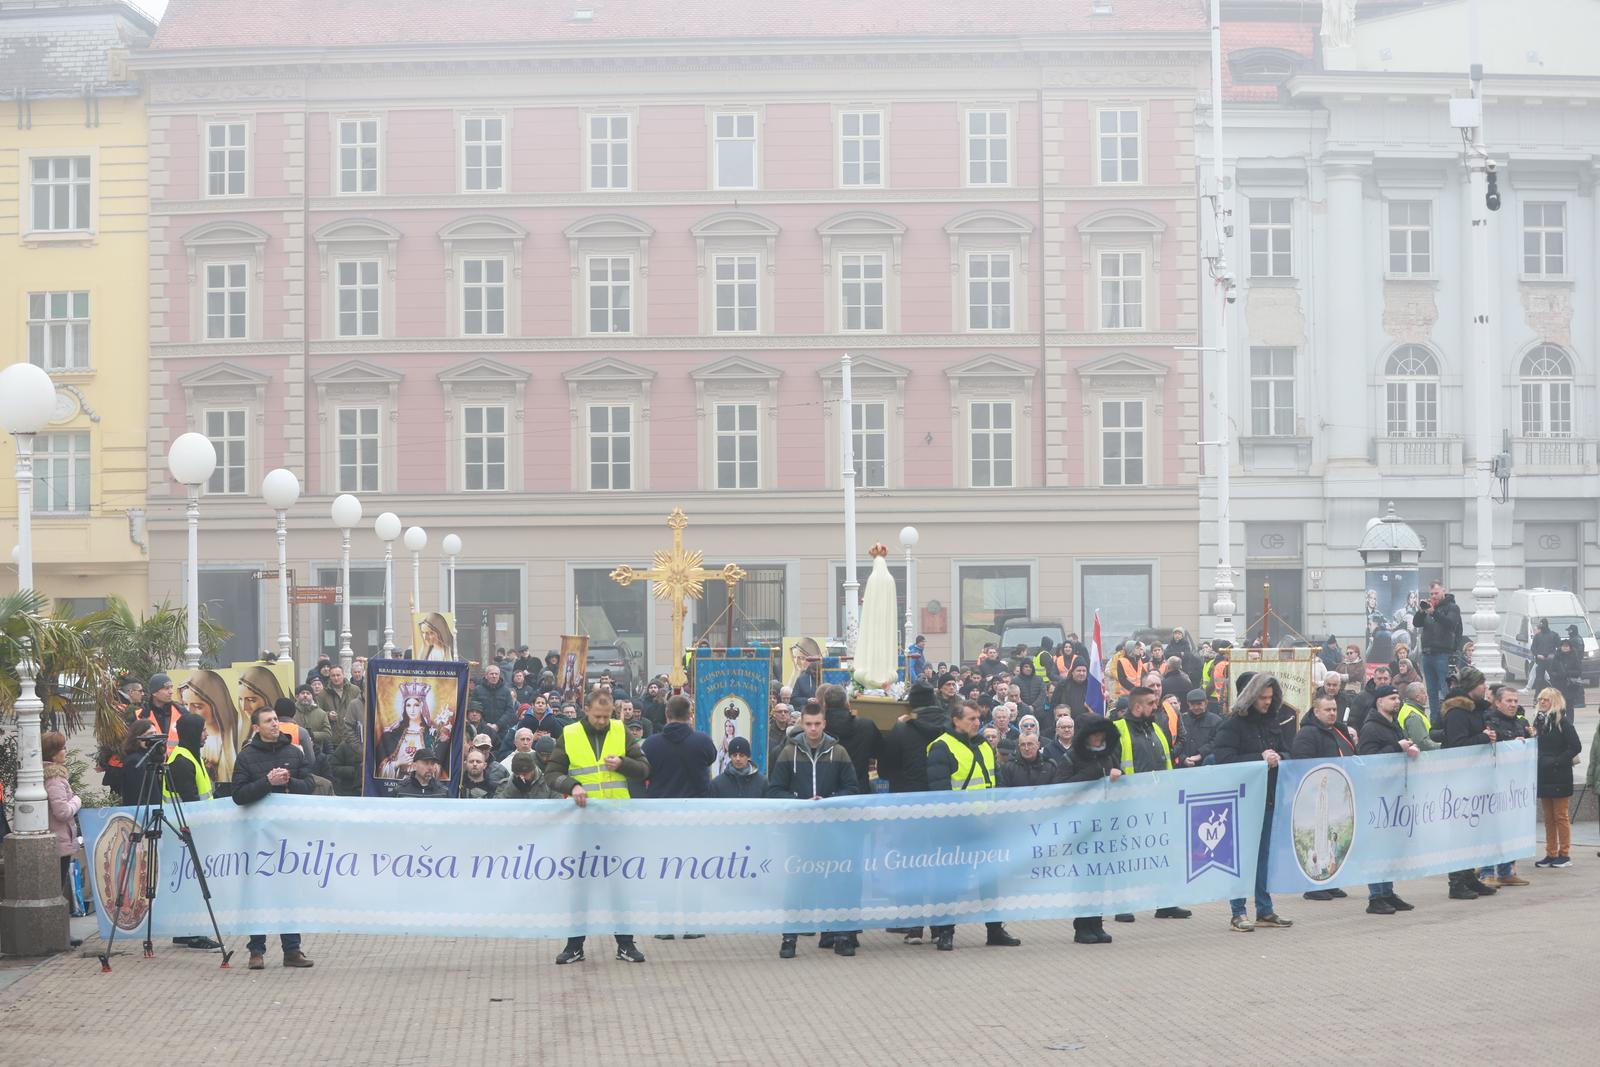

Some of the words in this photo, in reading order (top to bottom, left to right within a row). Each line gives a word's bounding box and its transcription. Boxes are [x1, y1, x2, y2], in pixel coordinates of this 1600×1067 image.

[1029, 810, 1169, 838] VITEZOVI
[1031, 832, 1170, 860] BEZGREŠNOG
[203, 850, 250, 880] sam
[254, 839, 360, 889] zbilja
[371, 844, 460, 880] vaša
[470, 843, 647, 881] milostiva
[658, 845, 773, 881] mati.«
[783, 854, 854, 879] Gospa
[863, 856, 879, 872] u
[883, 845, 1012, 872] Guadalupeu
[1030, 861, 1080, 880] SRCA
[1086, 854, 1170, 877] MARIJINA
